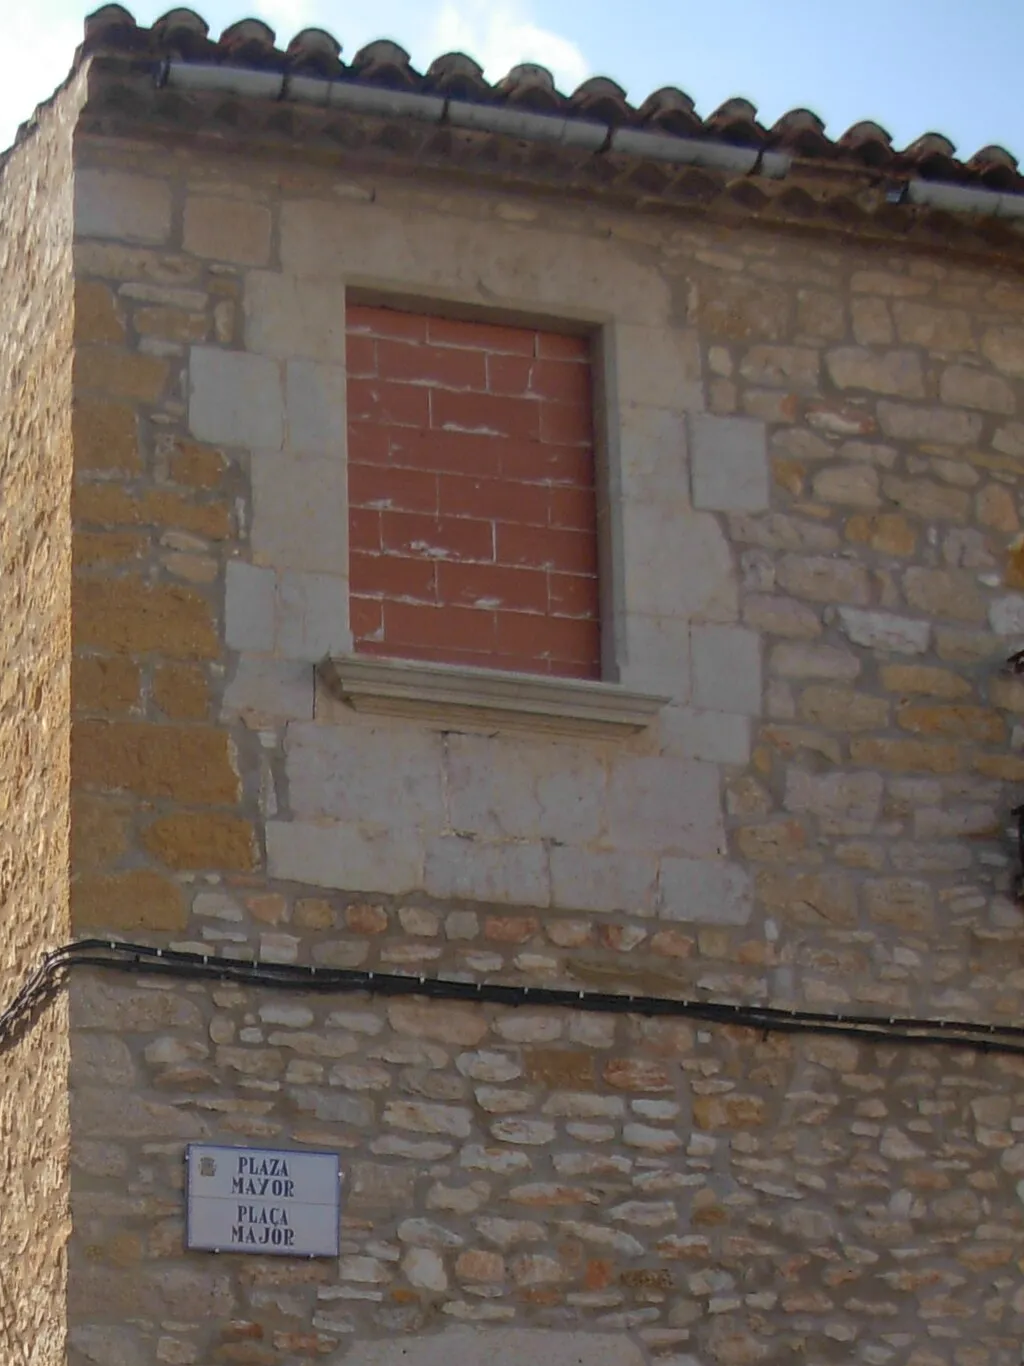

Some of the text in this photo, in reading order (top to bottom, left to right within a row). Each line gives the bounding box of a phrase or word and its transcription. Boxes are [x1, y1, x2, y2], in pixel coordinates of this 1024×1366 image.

[238, 1157, 289, 1176] PLAZA
[231, 1177, 295, 1197] MAYOR
[237, 1205, 289, 1226] PLAÇA
[231, 1225, 295, 1246] MAJOR
